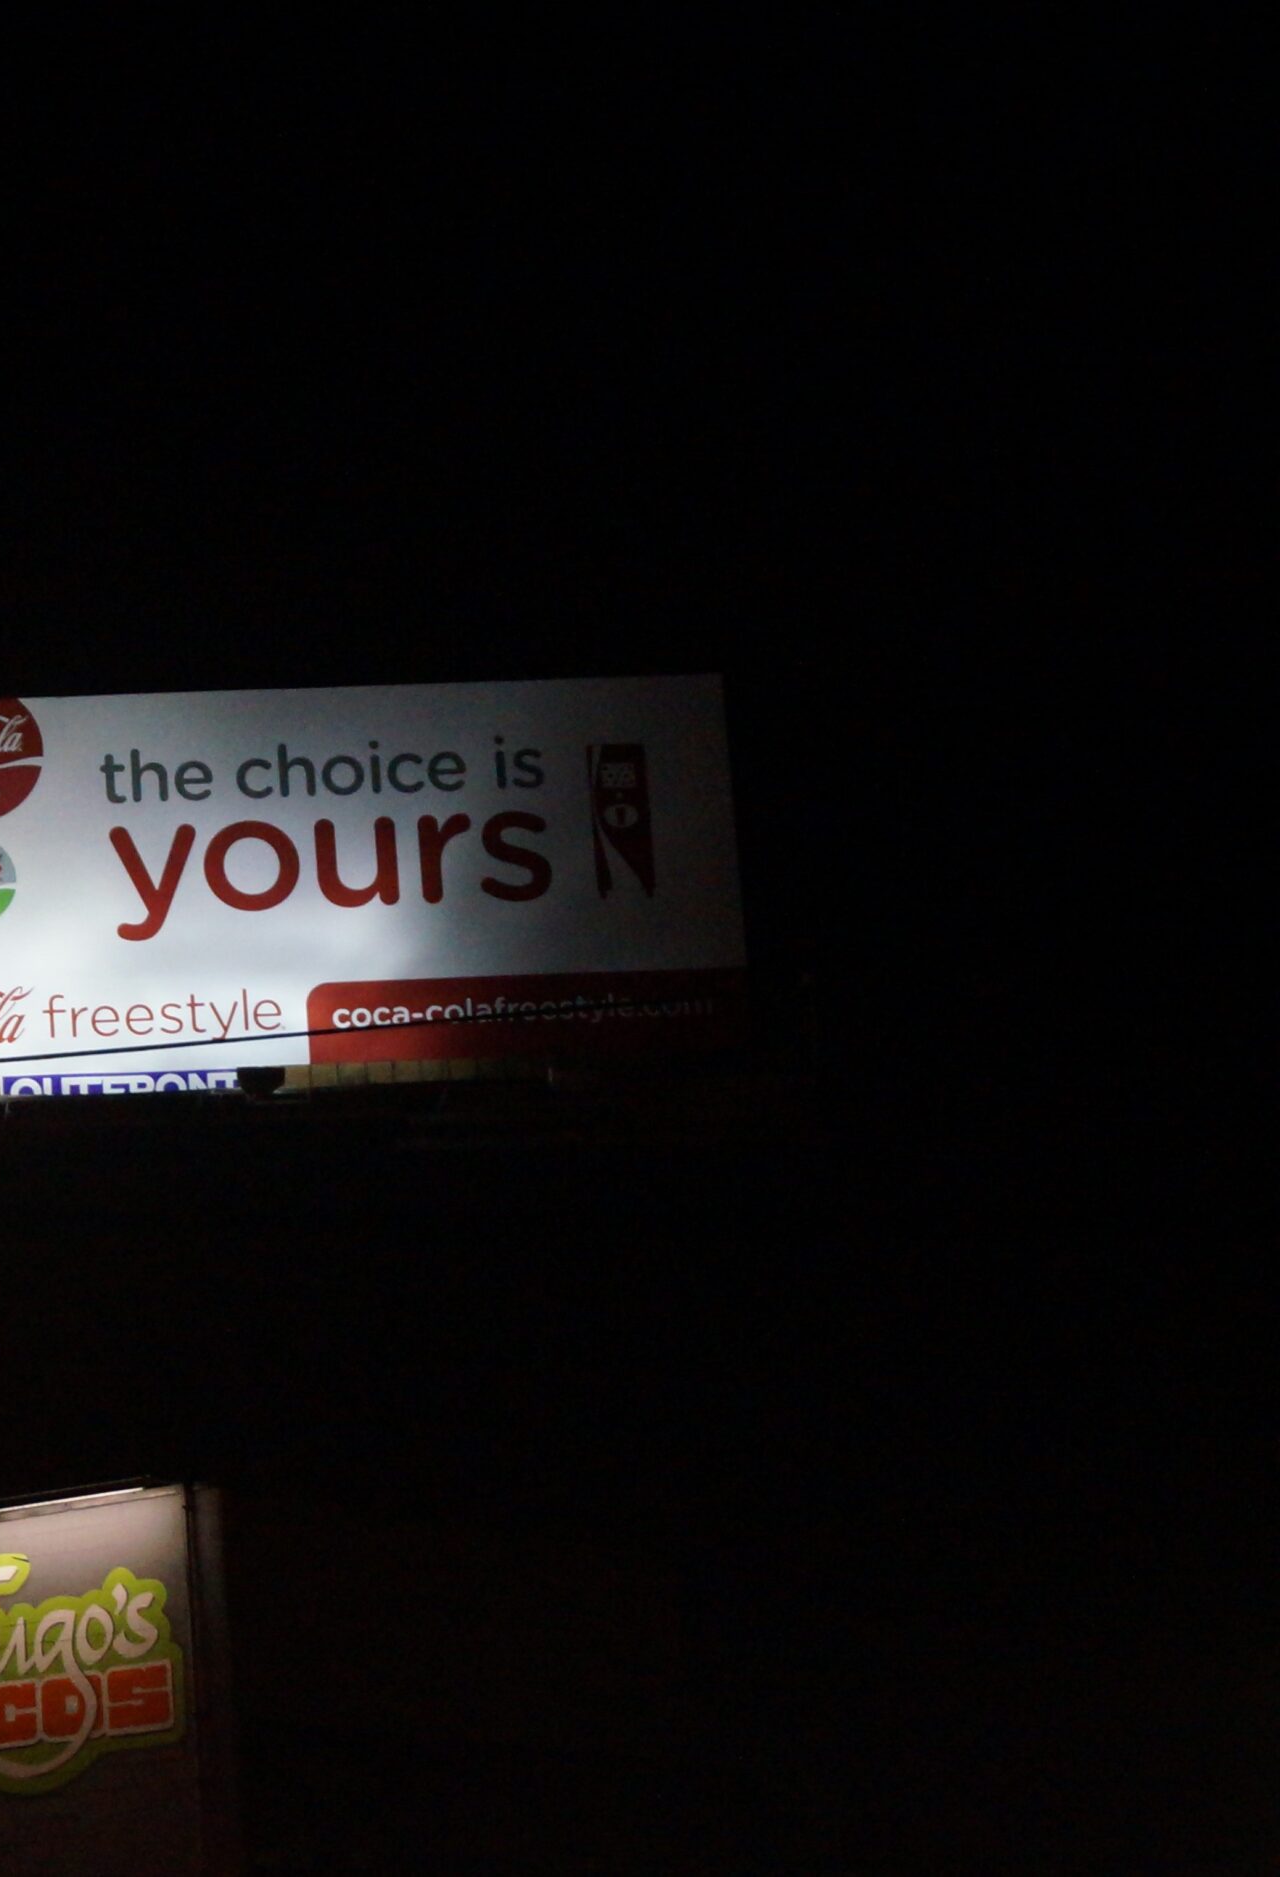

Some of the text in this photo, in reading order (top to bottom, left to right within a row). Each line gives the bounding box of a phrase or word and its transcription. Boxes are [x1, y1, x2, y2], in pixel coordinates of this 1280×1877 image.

[100, 735, 545, 803] the choice is
[108, 811, 553, 942] yours
